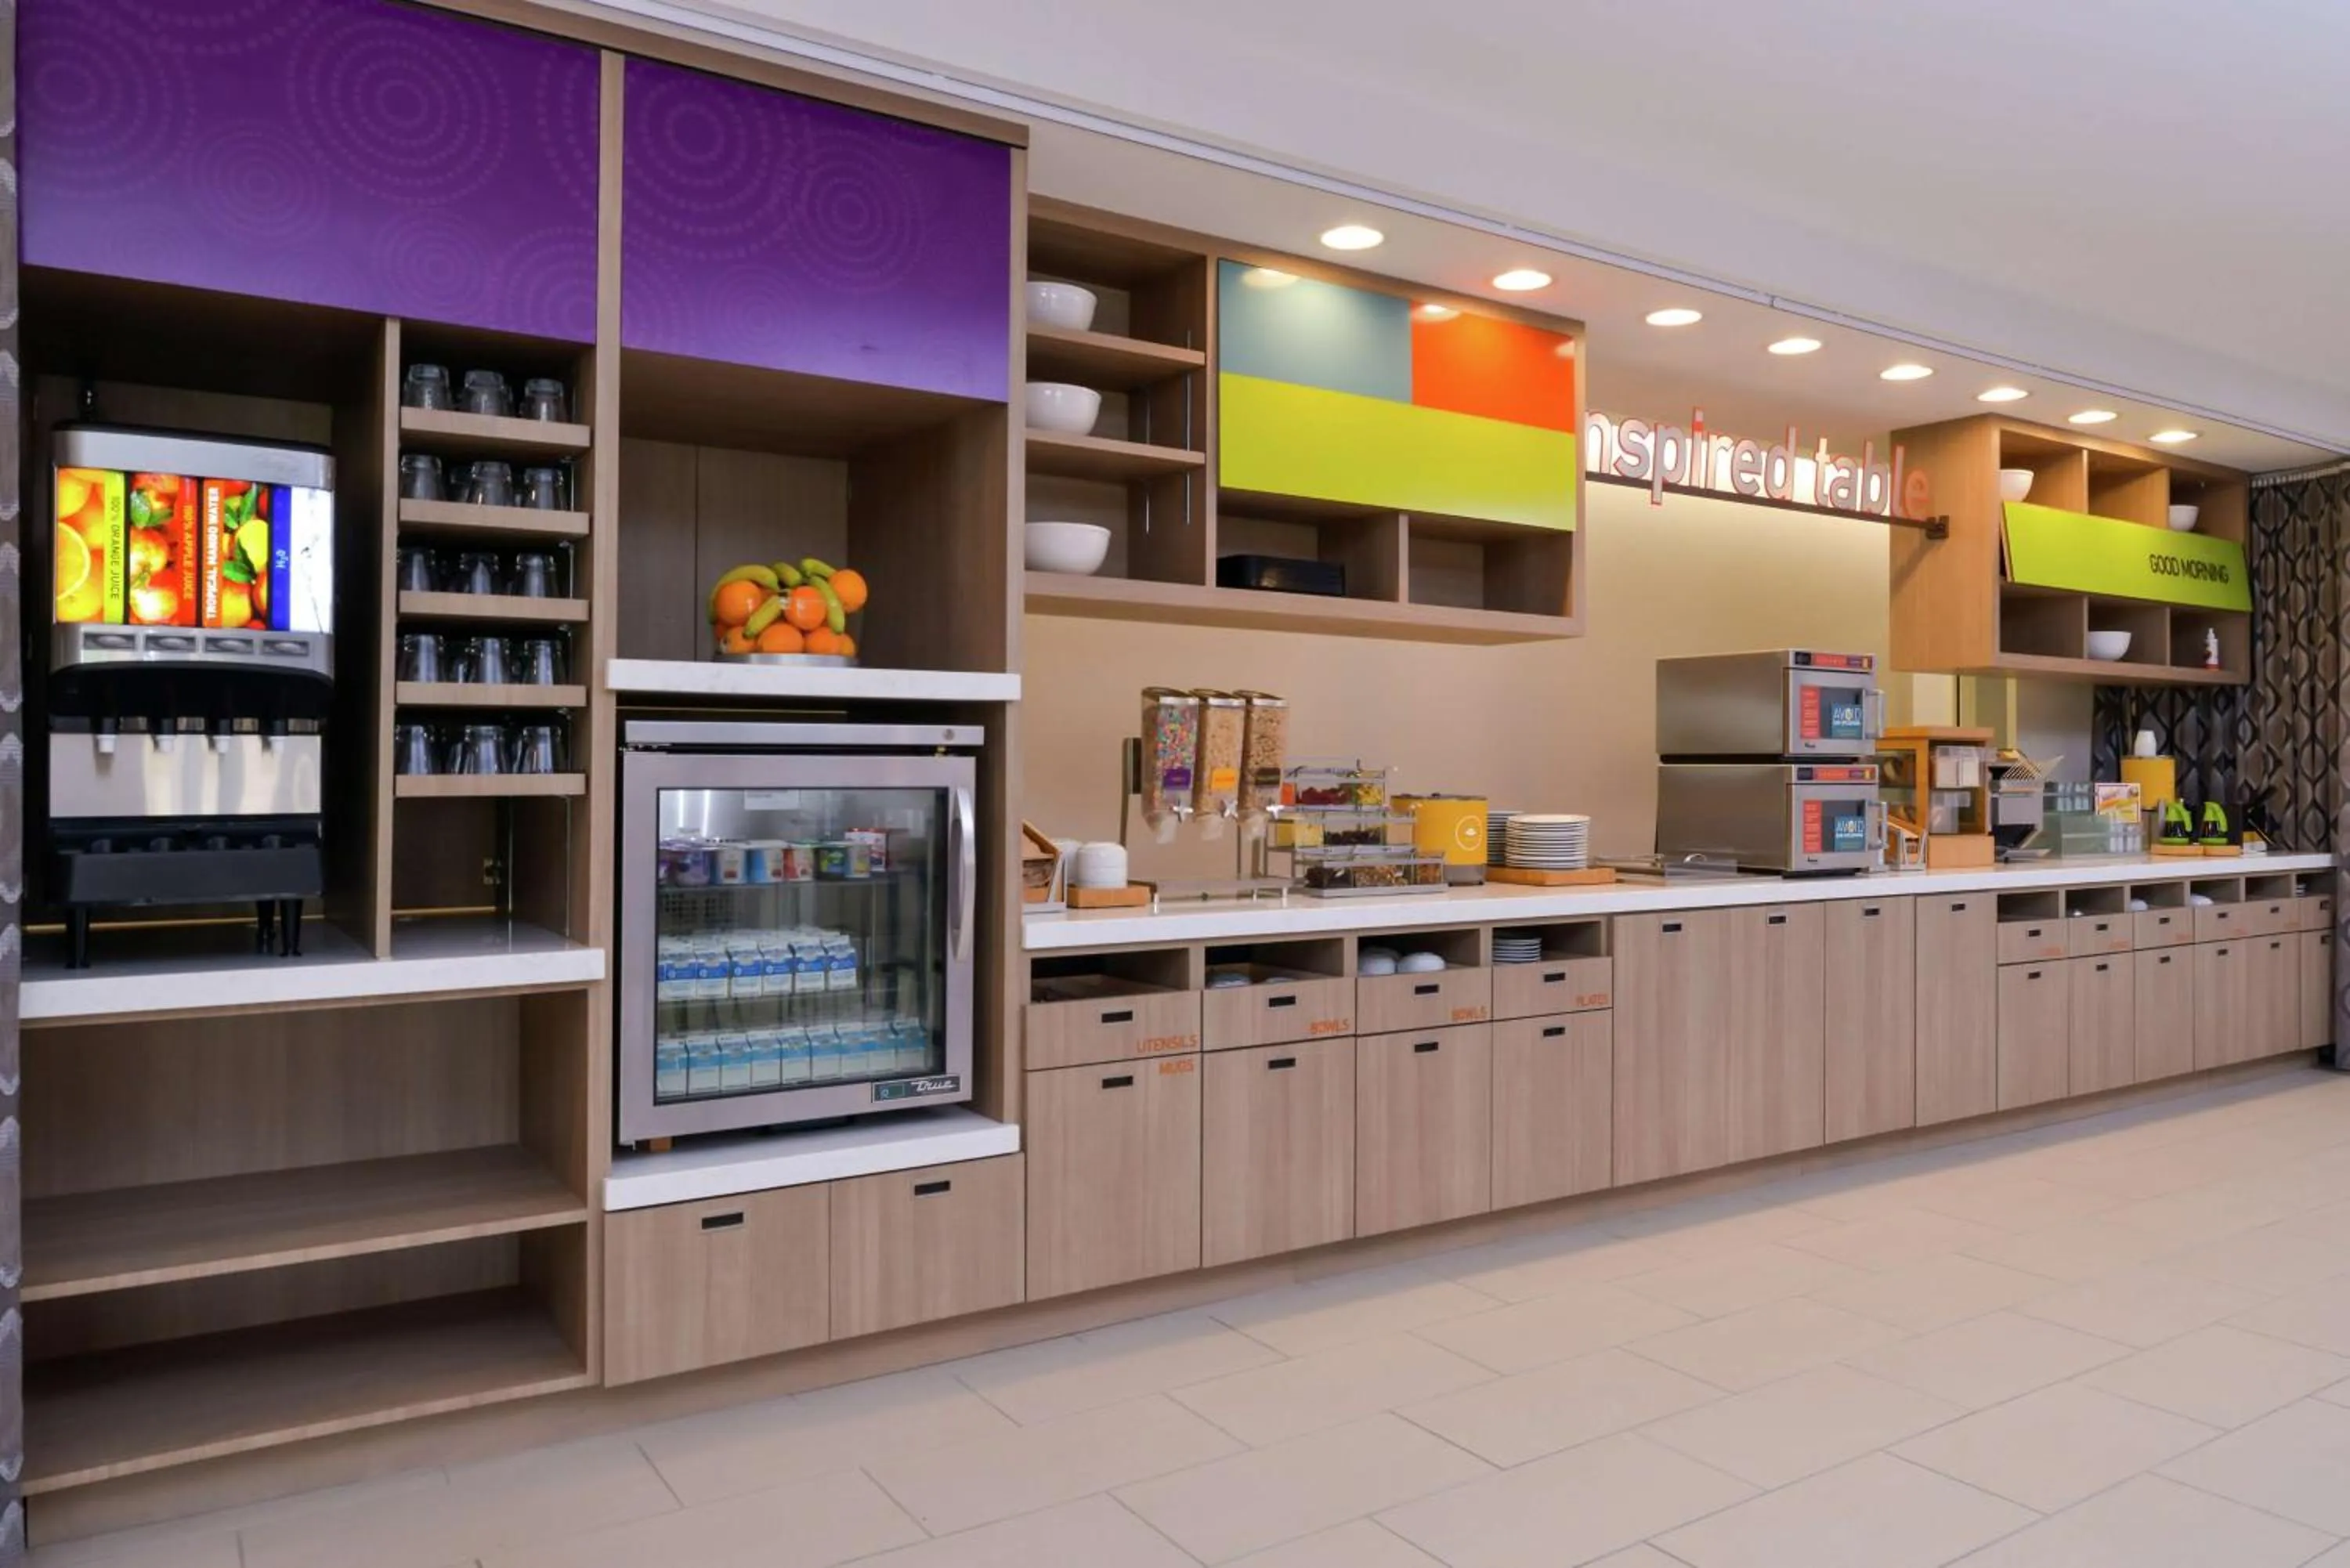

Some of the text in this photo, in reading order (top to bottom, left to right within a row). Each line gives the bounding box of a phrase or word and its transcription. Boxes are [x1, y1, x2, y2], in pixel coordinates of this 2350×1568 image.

[1585, 406, 1931, 522] nspired table
[110, 525, 121, 565] ORANGE
[183, 532, 193, 567] APPLE
[110, 568, 120, 599] JUICE
[2149, 553, 2229, 584] GOOD MORNING
[183, 570, 193, 600] JUICE
[1310, 1017, 1350, 1035] BOWLS
[1137, 1034, 1198, 1053] UTENSILS
